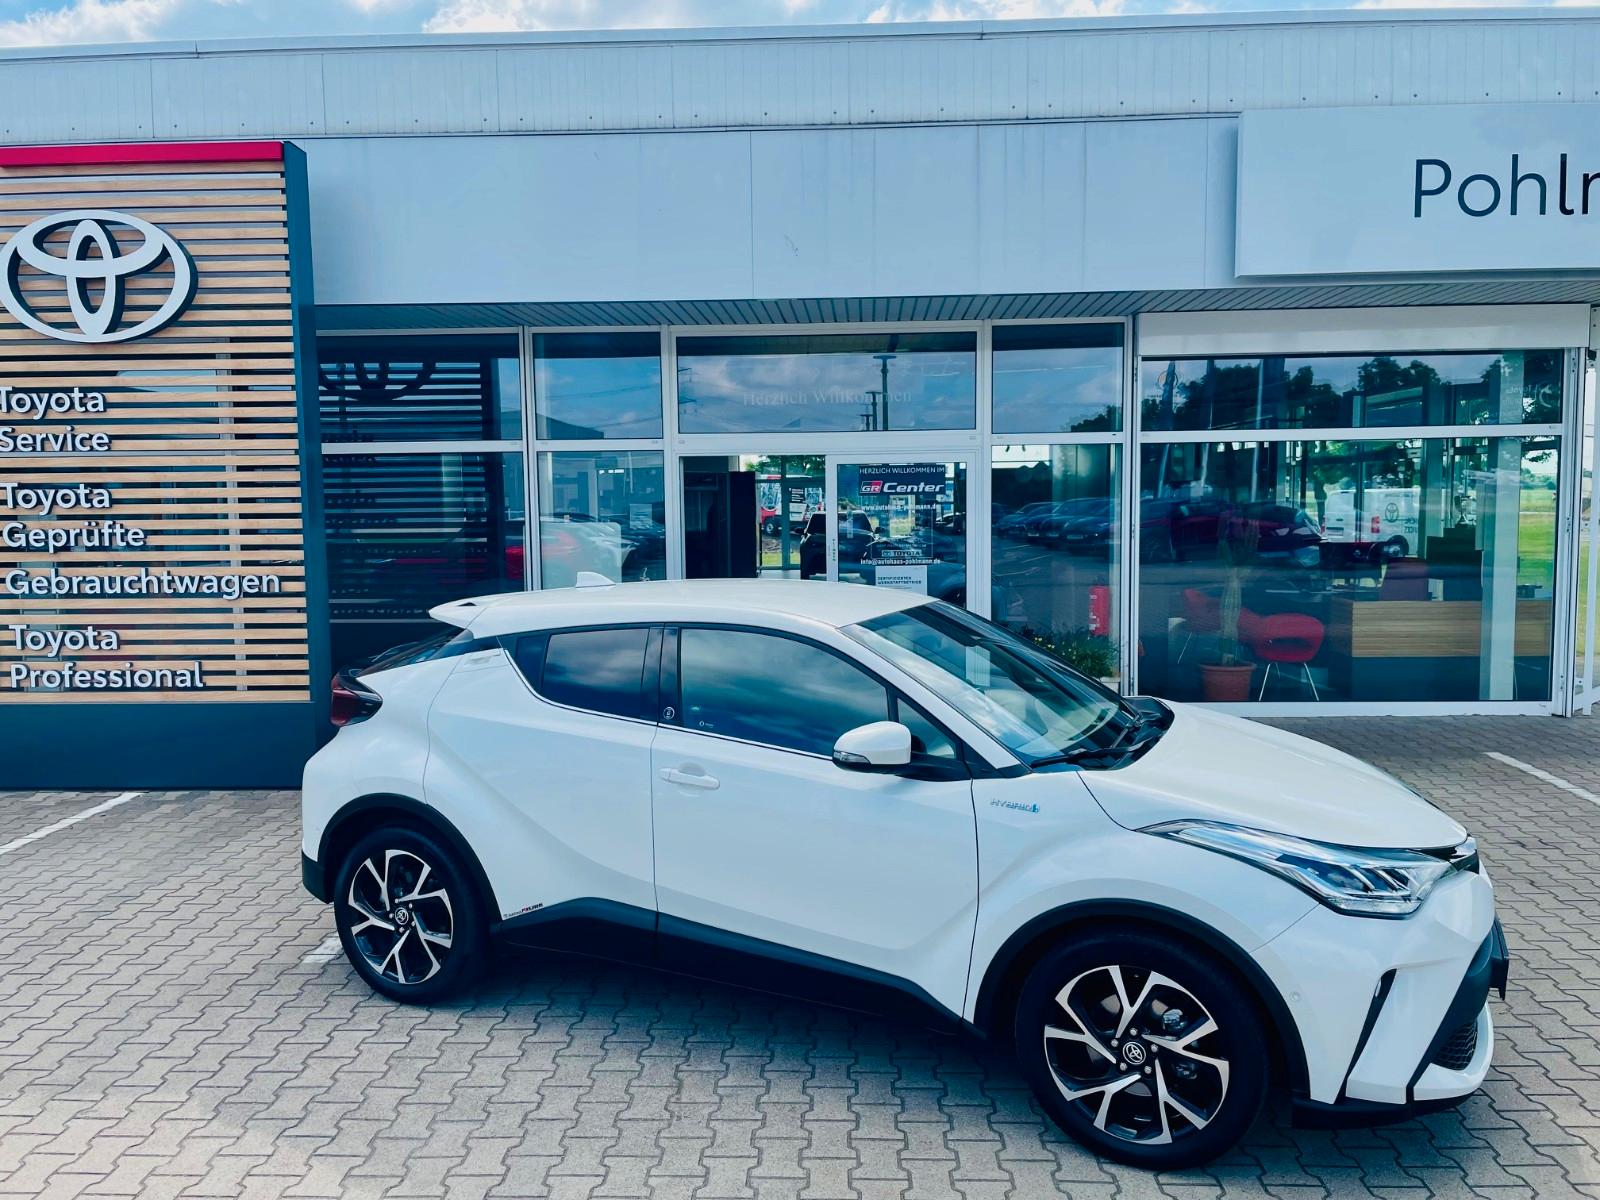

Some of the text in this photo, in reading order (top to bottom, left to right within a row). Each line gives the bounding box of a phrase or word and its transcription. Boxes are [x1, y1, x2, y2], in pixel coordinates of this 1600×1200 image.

[0, 386, 105, 420] Toyota
[0, 426, 110, 452] Service
[3, 483, 111, 515] Toyota
[883, 482, 945, 493] Center
[2, 522, 145, 553] Geprüfte
[5, 568, 281, 600] Gebrauchtwagen
[9, 624, 118, 656] Toyota
[10, 661, 203, 688] Professional
